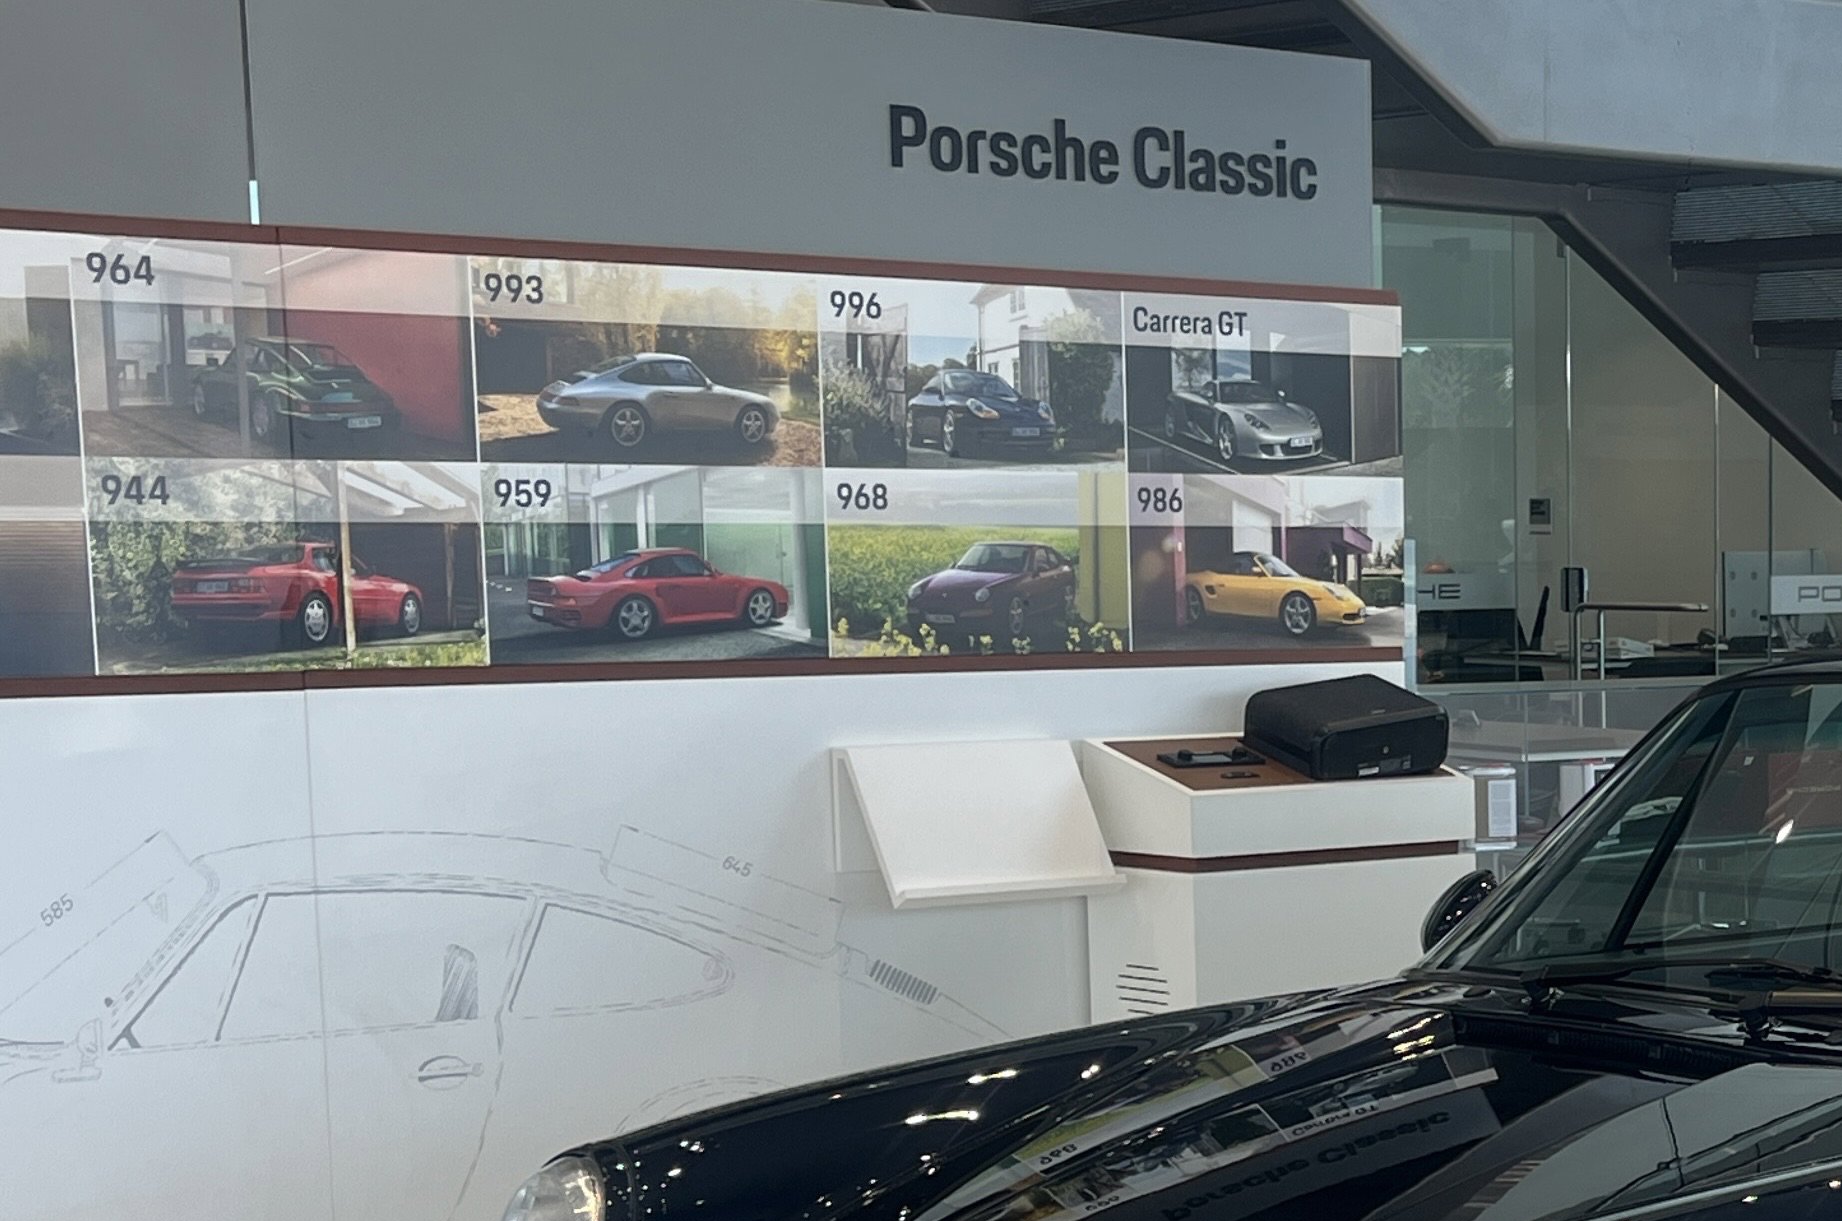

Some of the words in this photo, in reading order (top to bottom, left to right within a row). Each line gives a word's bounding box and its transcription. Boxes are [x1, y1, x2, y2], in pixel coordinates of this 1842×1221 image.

[889, 104, 1119, 184] Porsche
[1133, 127, 1318, 199] Classic
[86, 252, 154, 287] 964
[484, 273, 544, 305] 993
[830, 291, 882, 320] 996
[1133, 306, 1213, 336] Carrera
[1217, 311, 1248, 336] GT
[101, 474, 170, 507] 944
[494, 479, 552, 509] 959
[837, 484, 888, 511] 968
[1137, 487, 1183, 514] 986
[721, 853, 754, 879] 645
[40, 893, 75, 928] 585
